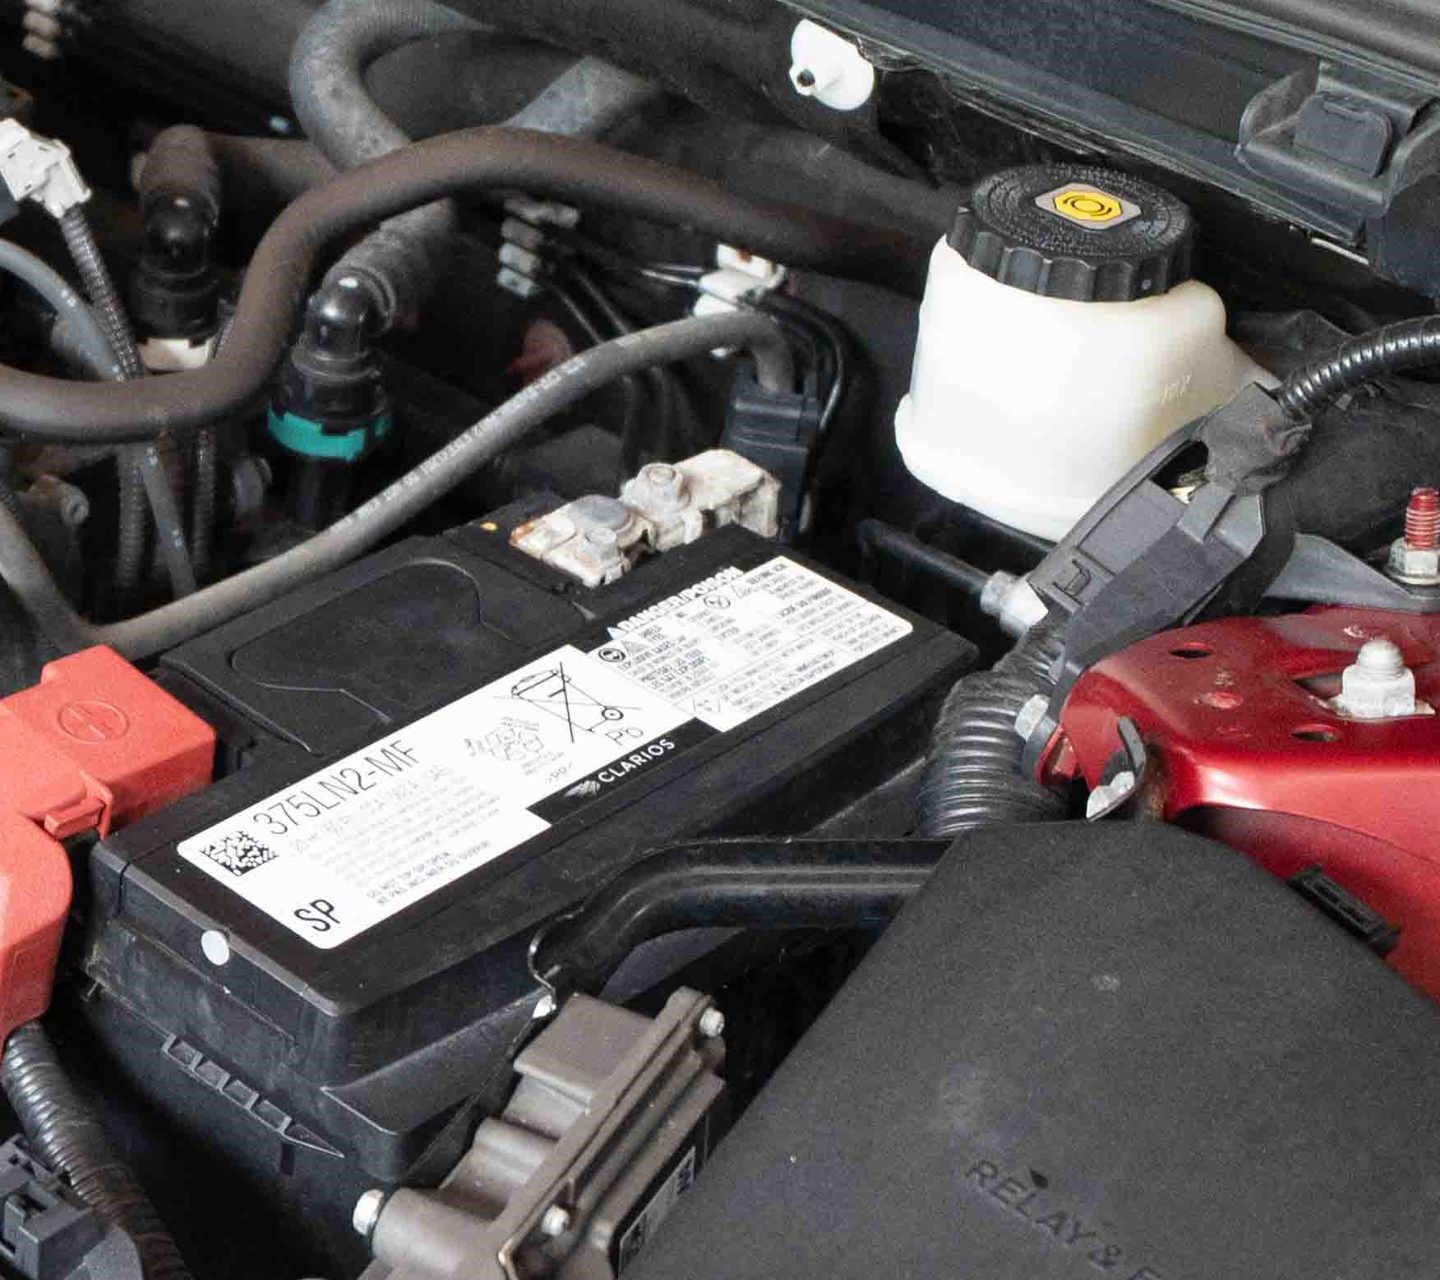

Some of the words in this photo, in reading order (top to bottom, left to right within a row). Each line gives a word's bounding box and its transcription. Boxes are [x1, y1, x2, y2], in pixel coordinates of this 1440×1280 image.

[252, 739, 421, 836] 375LN2-MF
[598, 737, 676, 785] CLARIOS
[293, 898, 341, 933] SP
[964, 1157, 1098, 1249] RELAY
[1087, 1242, 1123, 1271] &
